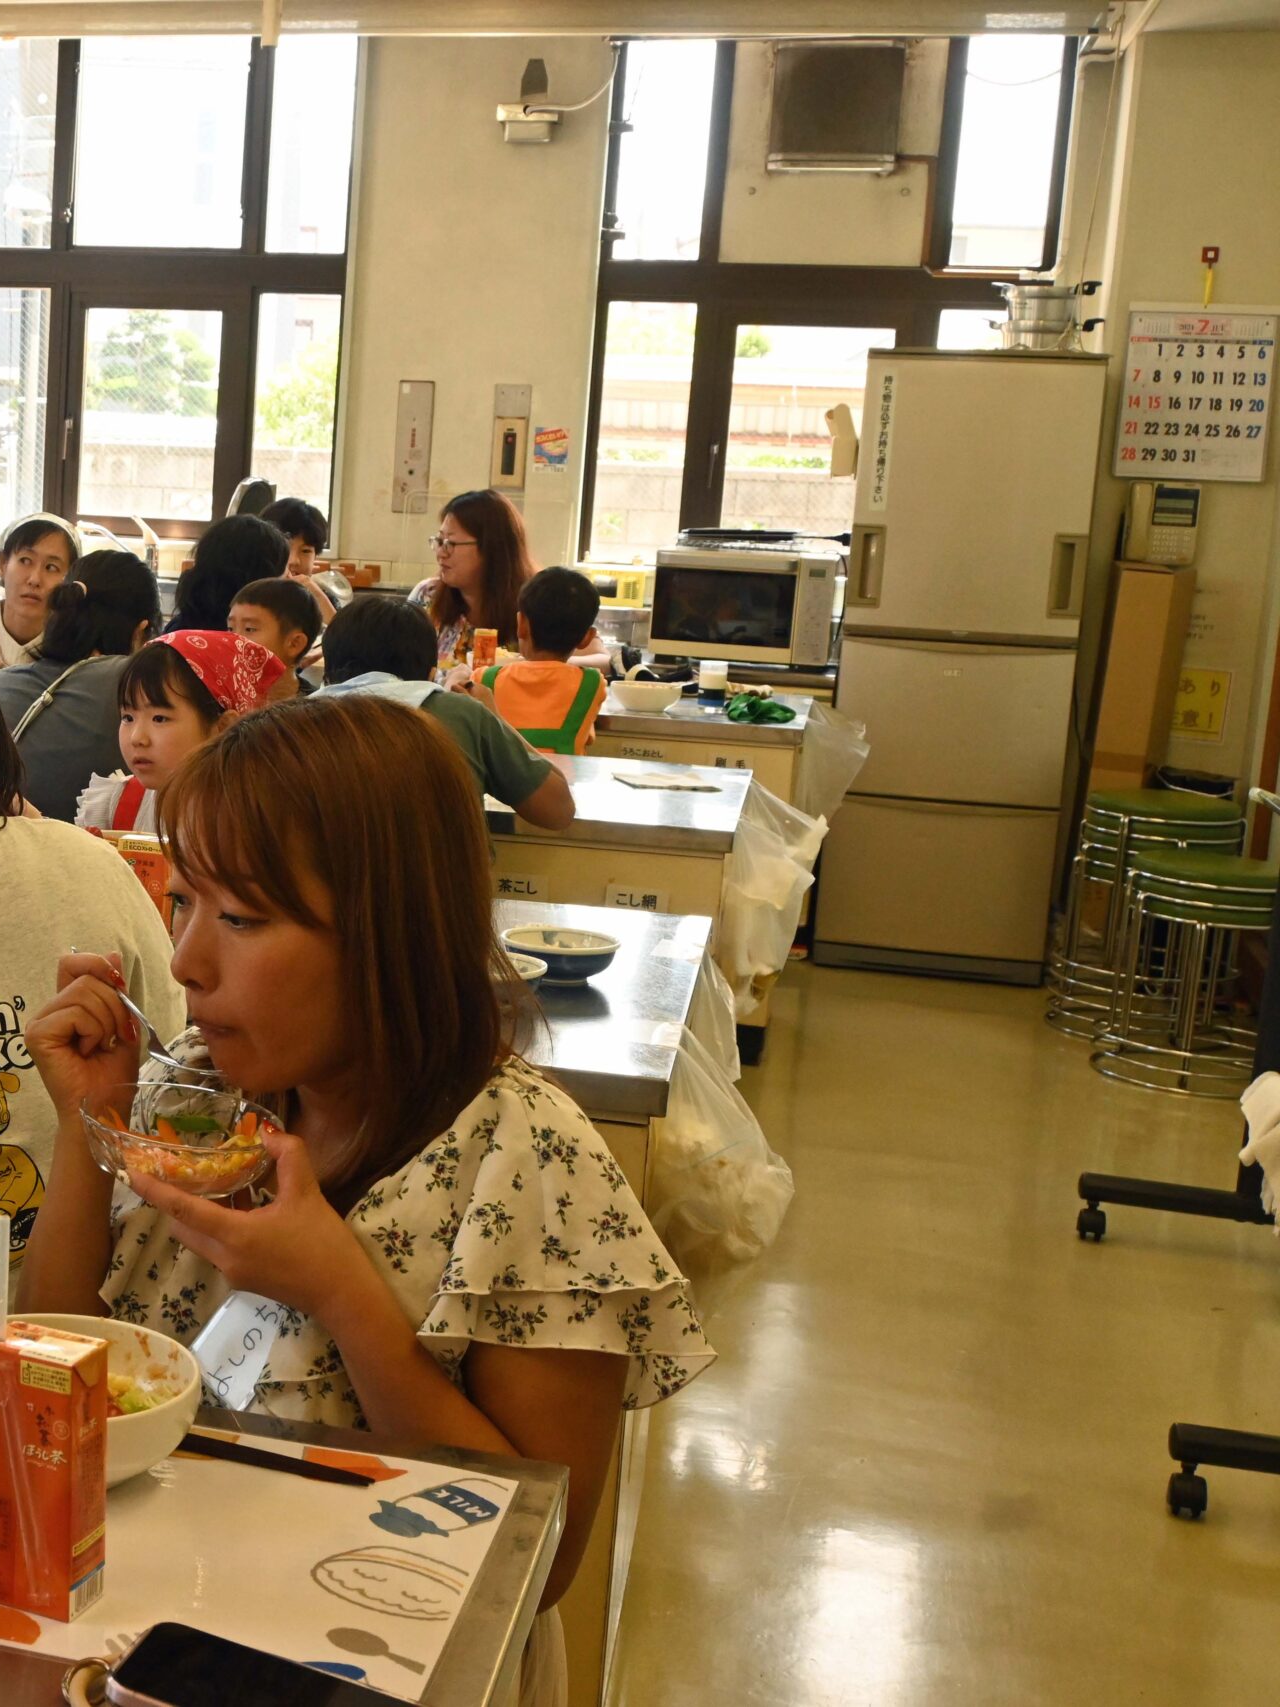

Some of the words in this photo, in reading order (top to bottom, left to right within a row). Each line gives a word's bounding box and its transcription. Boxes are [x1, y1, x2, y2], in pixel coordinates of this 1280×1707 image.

[1198, 319, 1210, 332] 7
[1157, 344, 1163, 356] 1
[1176, 344, 1185, 357] 2
[1196, 345, 1205, 358] 3
[1217, 345, 1224, 358] 4
[1237, 346, 1245, 359] 5
[1258, 346, 1266, 359] 6
[1133, 369, 1141, 382] 7
[1153, 370, 1161, 382] 8
[1174, 370, 1182, 383] 9
[1191, 371, 1204, 384] 10
[1213, 371, 1223, 385] 11
[1232, 372, 1246, 385] 12
[1253, 372, 1266, 386] 13
[1128, 395, 1140, 408] 14
[1148, 396, 1160, 409] 15
[1168, 397, 1181, 410] 16
[1189, 397, 1202, 410] 17
[1209, 398, 1222, 411] 18
[1230, 398, 1243, 411] 19
[1249, 399, 1264, 412] 20
[1124, 422, 1137, 435] 21
[1144, 422, 1159, 435] 22
[1164, 423, 1179, 436] 23
[1184, 423, 1199, 436] 24
[1205, 424, 1220, 437] 25
[1225, 425, 1240, 438] 26
[1246, 425, 1261, 438] 27
[1121, 448, 1136, 461] 28
[1141, 448, 1157, 461] 29
[1161, 449, 1177, 462] 30
[1182, 449, 1195, 463] 31
[623, 747, 663, 759] うろこおとし
[498, 878, 538, 895] 茶こし
[616, 892, 657, 910] こし網
[431, 1488, 491, 1518] MILK
